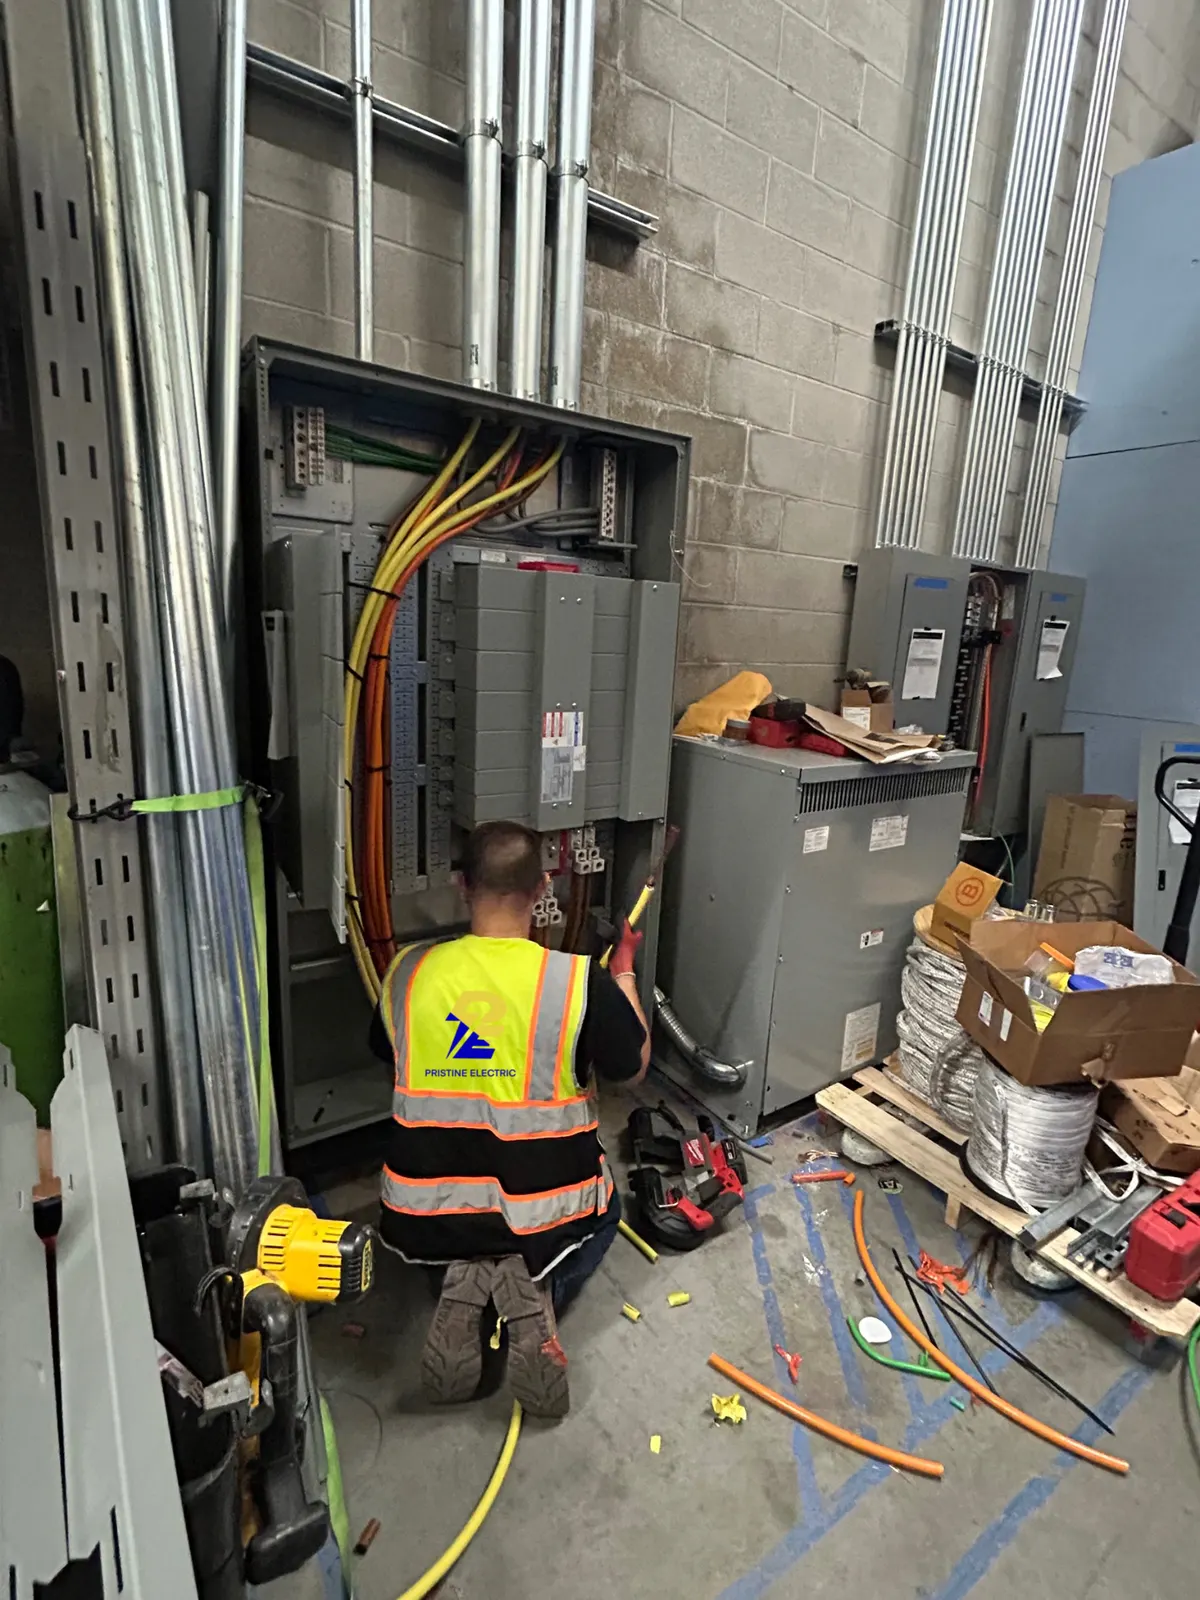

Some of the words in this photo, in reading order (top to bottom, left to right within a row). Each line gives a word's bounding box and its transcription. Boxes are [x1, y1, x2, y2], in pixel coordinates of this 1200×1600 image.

[962, 884, 979, 899] B
[424, 1068, 468, 1077] PRISTINE
[469, 1068, 517, 1077] ELECTRIC
